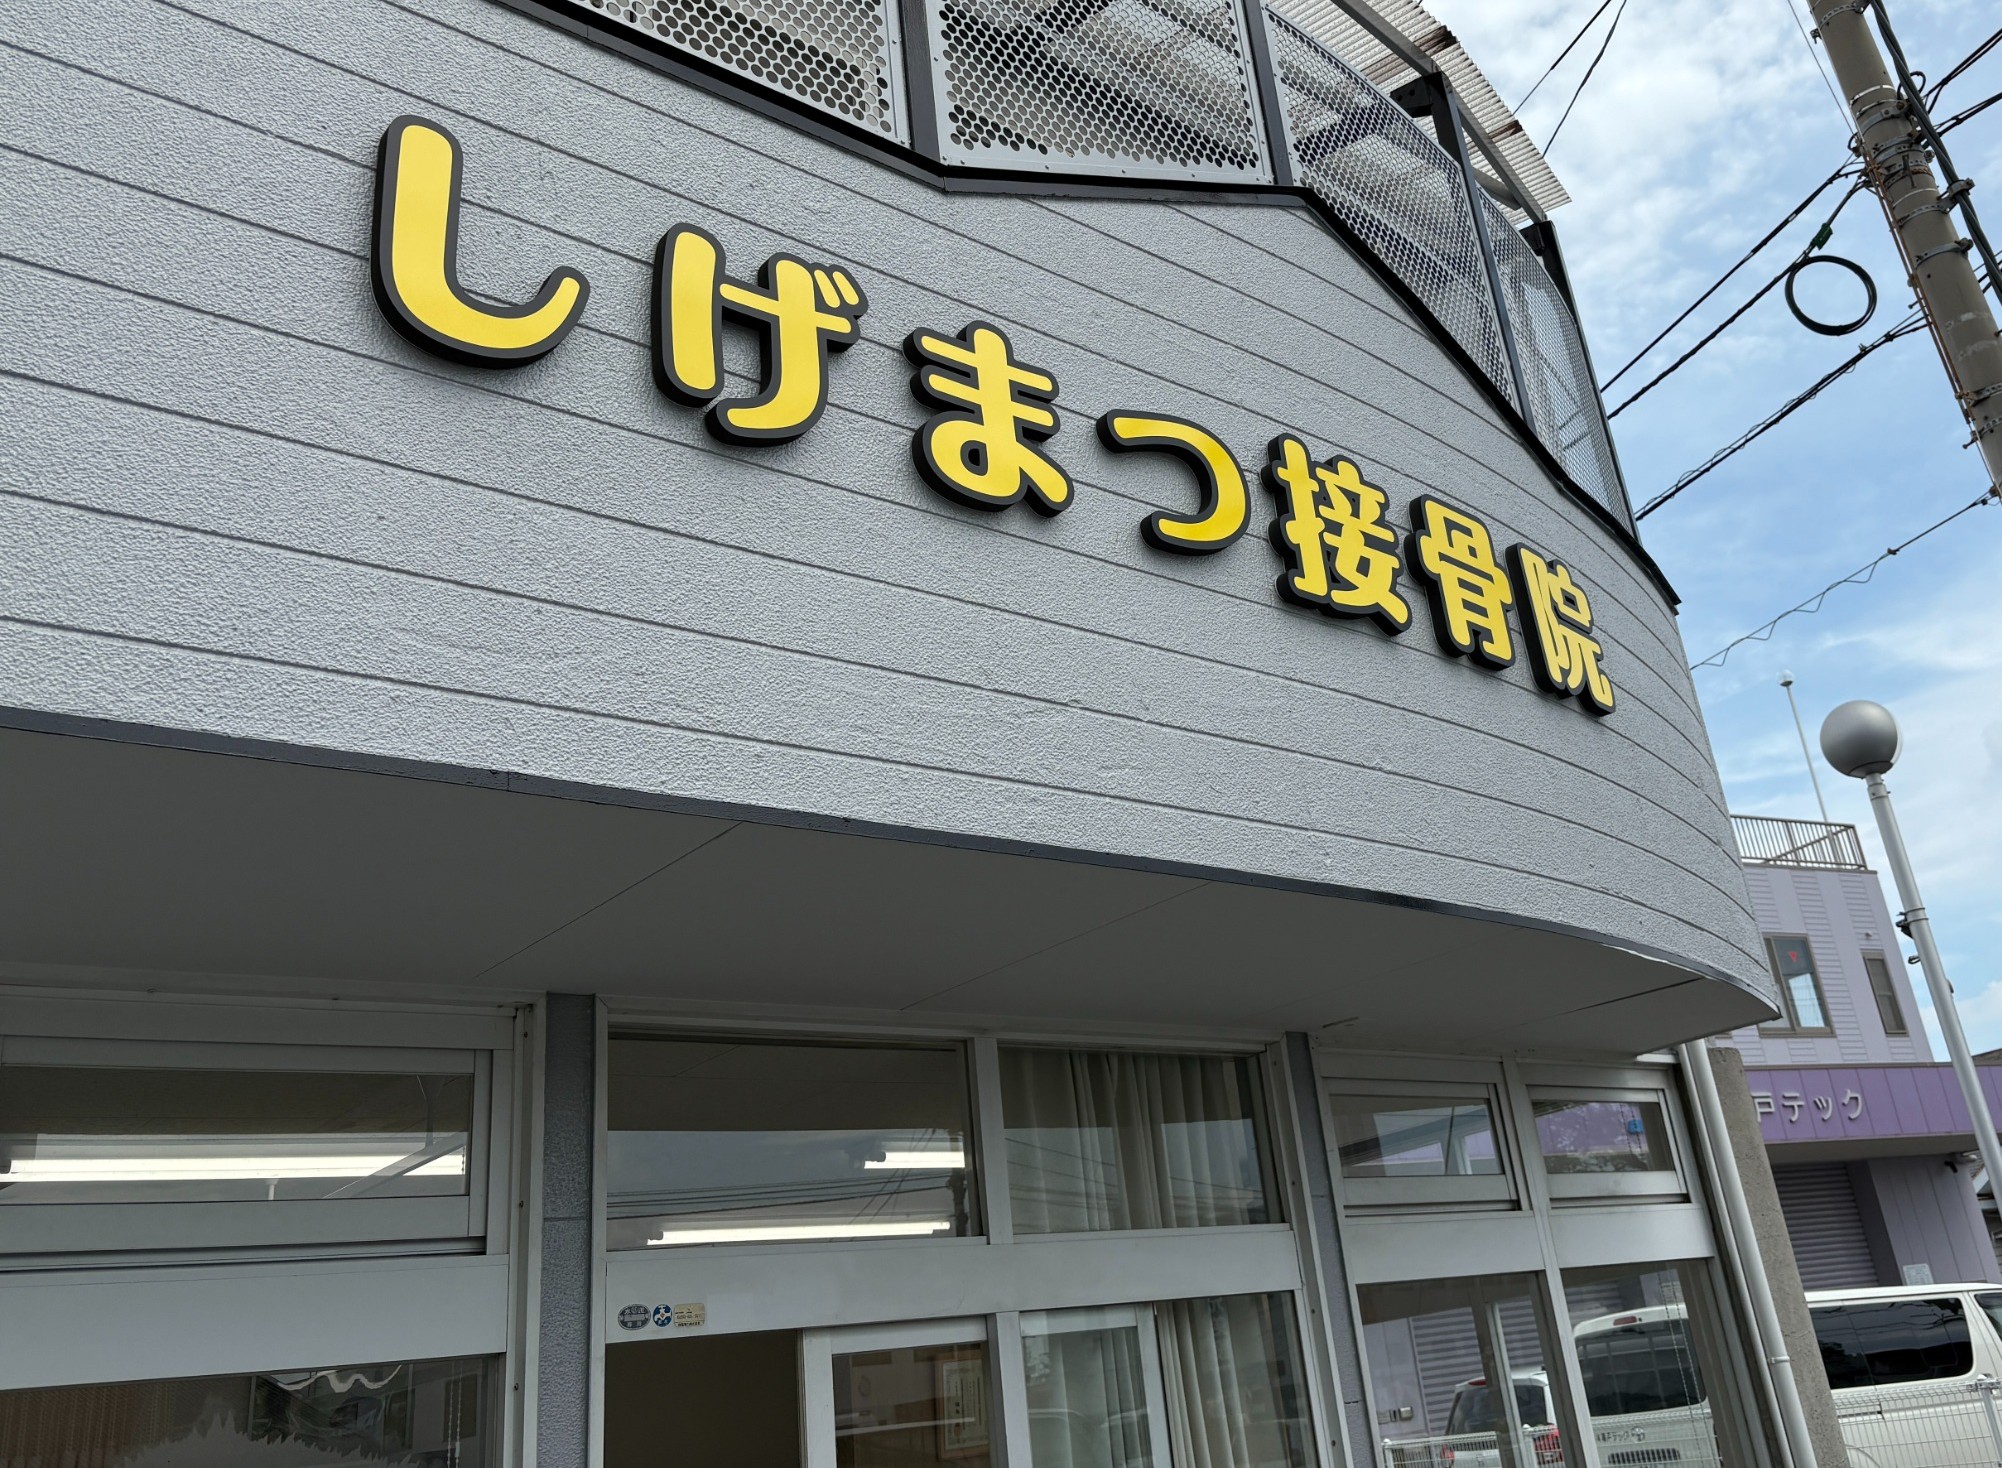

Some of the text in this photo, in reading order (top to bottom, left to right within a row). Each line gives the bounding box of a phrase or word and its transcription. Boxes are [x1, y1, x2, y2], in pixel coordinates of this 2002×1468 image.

[376, 117, 1615, 715] しげまつ接骨院
